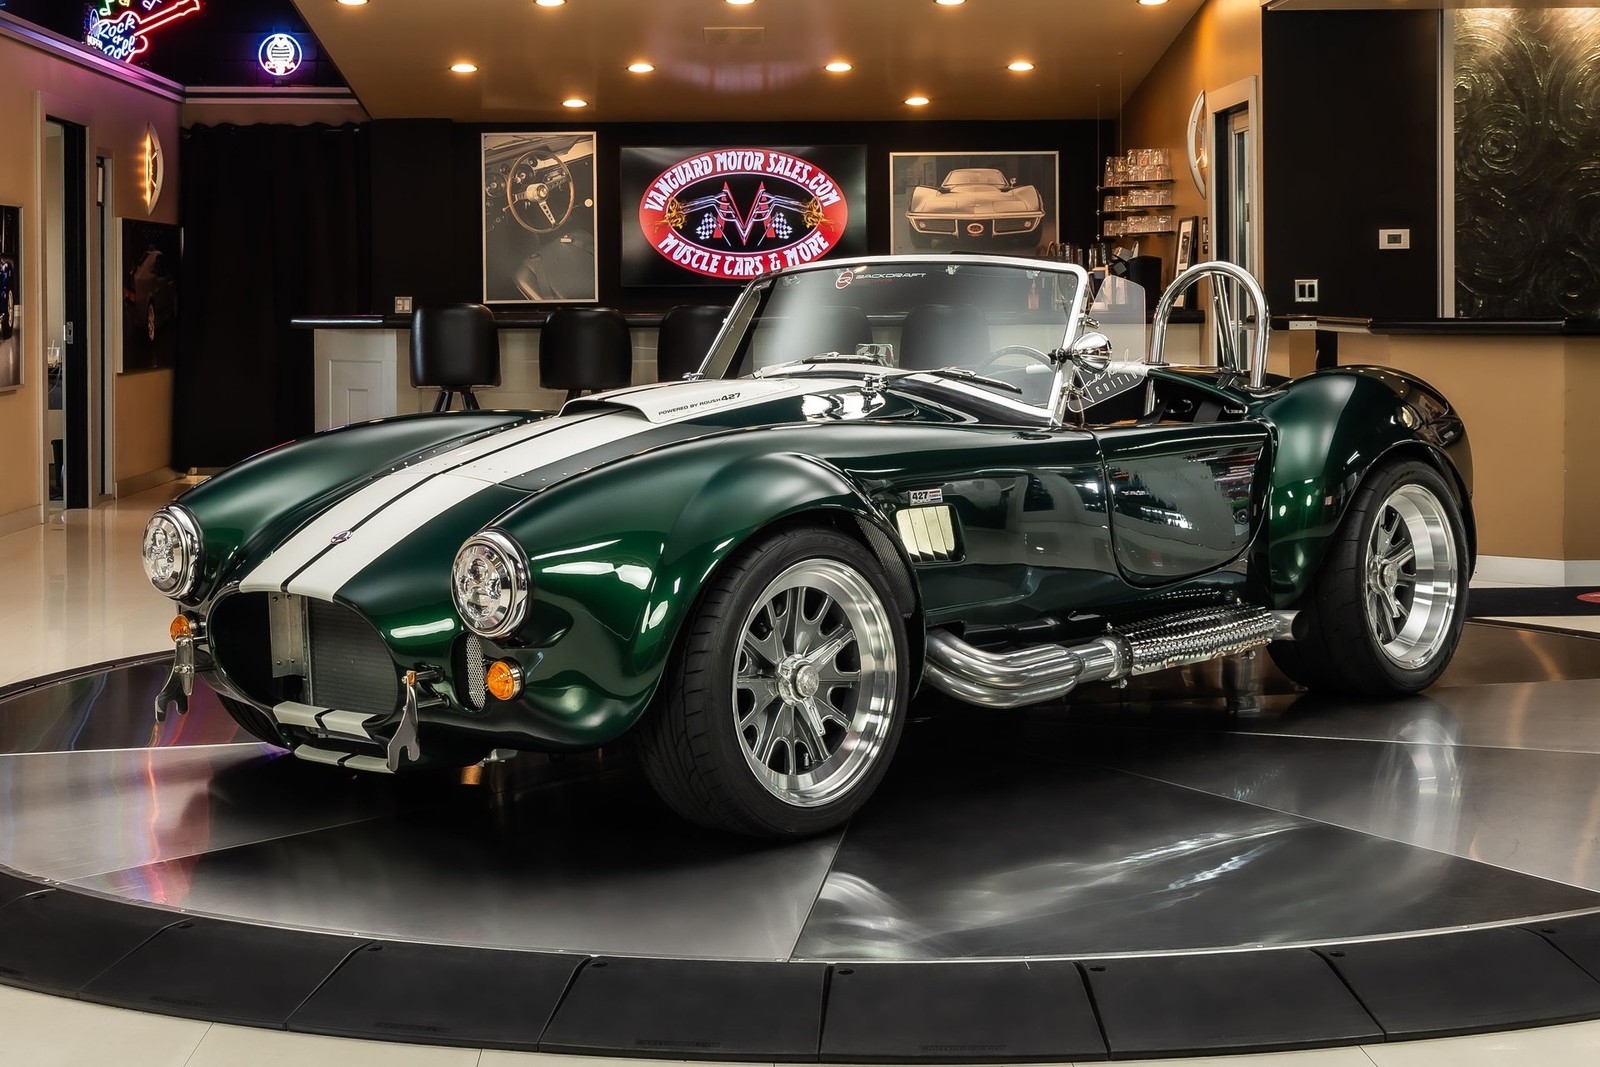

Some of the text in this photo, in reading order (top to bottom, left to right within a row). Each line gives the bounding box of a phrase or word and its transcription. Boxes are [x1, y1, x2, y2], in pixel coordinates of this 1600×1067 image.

[99, 13, 136, 39] Rock
[644, 151, 841, 212] VANGUARD MOTOR SALES.COM
[657, 230, 830, 275] MUSCLE CARS & MORE
[658, 405, 689, 415] POWERED
[699, 398, 721, 406] ROUSH
[721, 392, 741, 401] 427
[912, 491, 928, 500] 427
